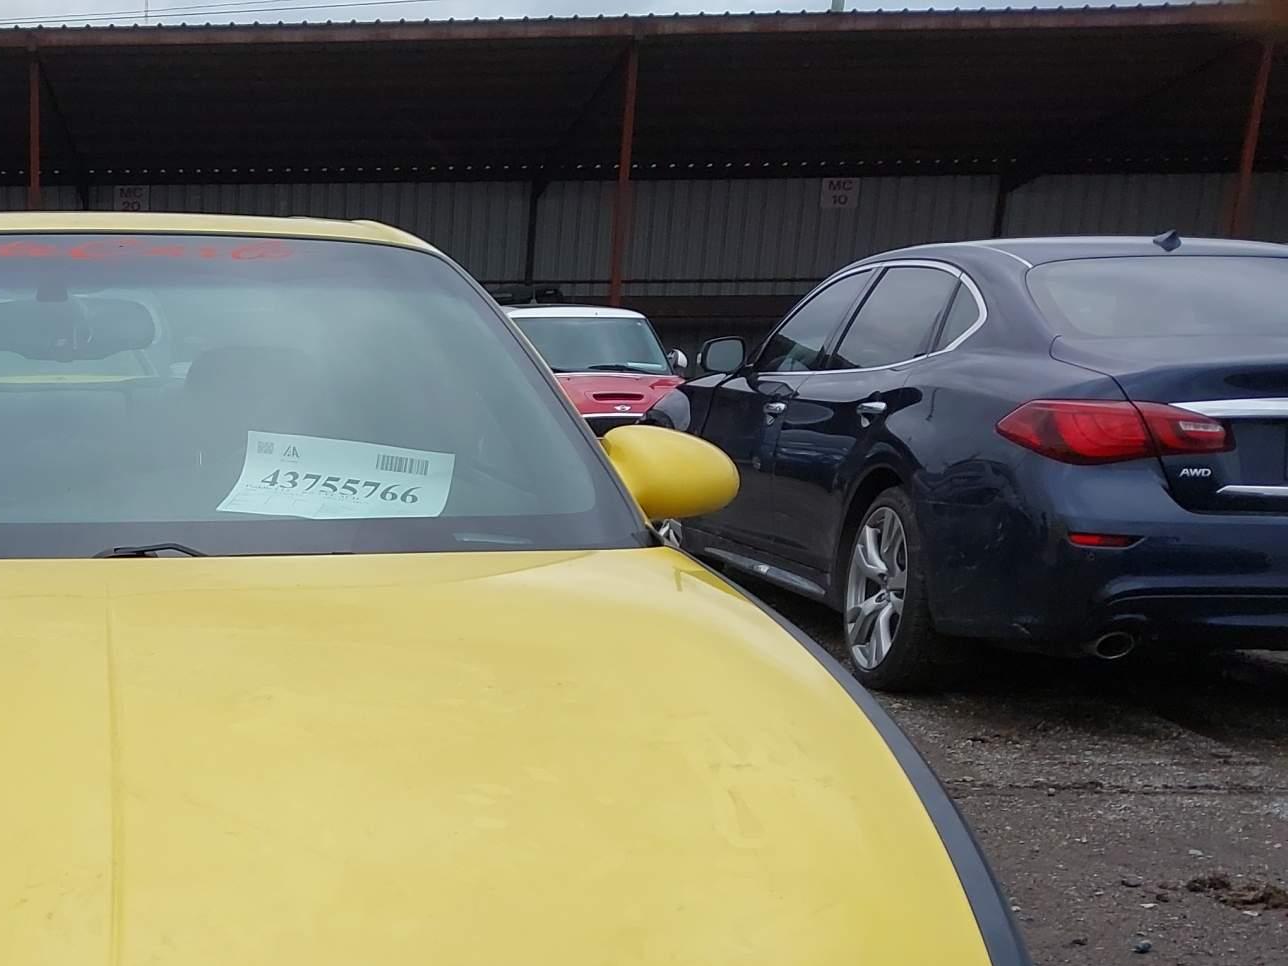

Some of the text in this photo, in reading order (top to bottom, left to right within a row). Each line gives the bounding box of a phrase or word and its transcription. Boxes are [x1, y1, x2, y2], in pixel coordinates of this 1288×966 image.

[828, 180, 853, 191] MC
[832, 194, 848, 205] 10
[1179, 468, 1212, 477] AWD
[260, 468, 423, 504] 43755766
